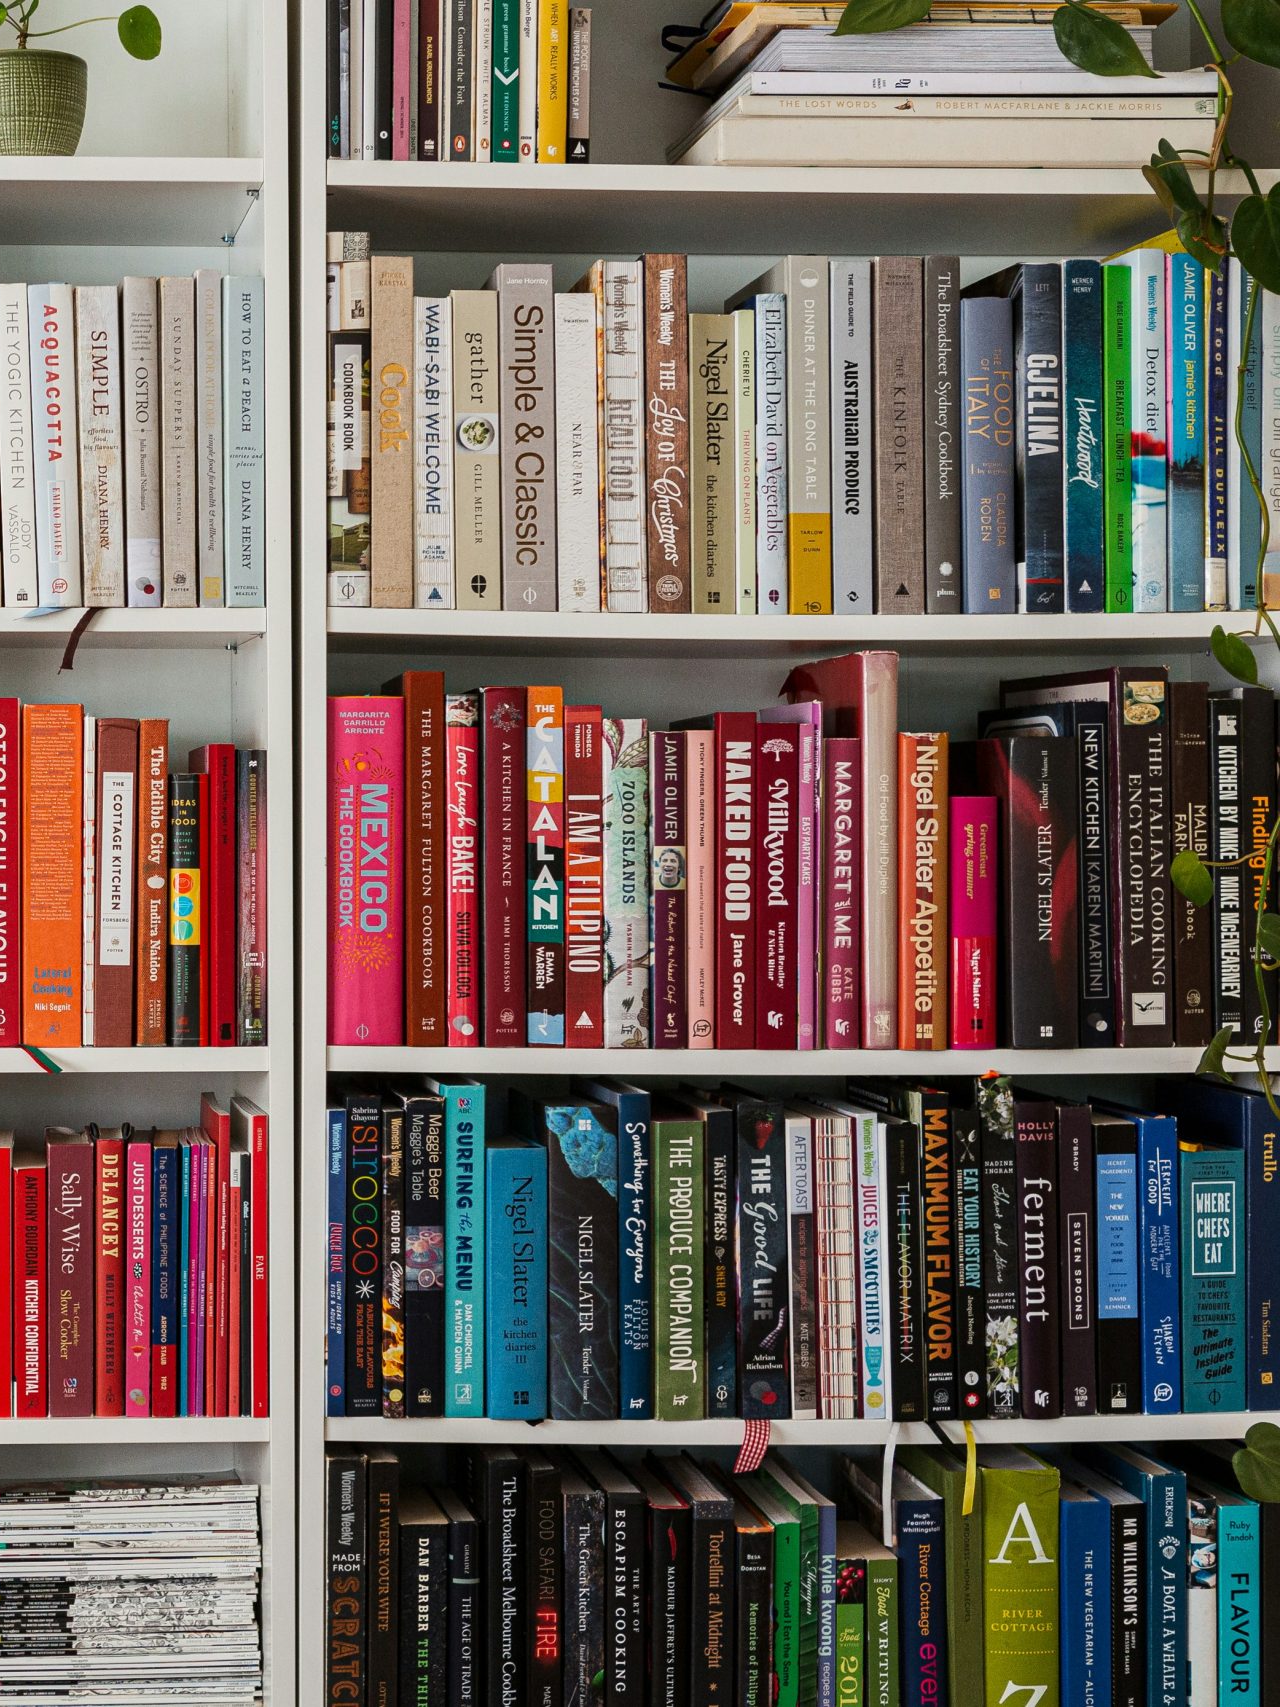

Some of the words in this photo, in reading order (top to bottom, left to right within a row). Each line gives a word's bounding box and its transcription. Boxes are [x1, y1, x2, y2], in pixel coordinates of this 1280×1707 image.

[457, 72, 465, 85] the
[457, 86, 465, 104] Fork
[806, 100, 831, 108] LOST
[40, 305, 62, 461] ACQUACOTTA
[91, 331, 109, 416] SIMPLE
[425, 305, 440, 408] WABI-SABI
[508, 305, 543, 411] Simple
[699, 338, 728, 396] Nigel
[1147, 348, 1159, 390] Detox
[344, 363, 353, 418] COOKBOOK
[1027, 354, 1058, 456] GJELINA
[1147, 397, 1159, 433] diet
[344, 424, 353, 450] BOOK
[515, 423, 544, 444] &
[706, 402, 728, 465] Slater
[426, 413, 441, 514] WELCOME
[242, 481, 251, 525] DIANA
[515, 452, 544, 565] Classic
[242, 531, 251, 569] HENRY
[910, 746, 938, 809] Nigel
[1085, 730, 1098, 770] NEW
[340, 785, 353, 816] THE
[726, 742, 751, 840] NAKED
[1086, 774, 1100, 851] KITCHEN
[340, 821, 353, 927] COOKBOOK
[360, 784, 388, 932] MEXICO
[916, 815, 938, 892] Slater
[726, 845, 750, 920] FOOD
[730, 933, 745, 967] Jane
[915, 899, 938, 1012] Appetite
[50, 1003, 70, 1012] Segnit
[733, 972, 745, 1025] Grover
[1018, 1122, 1054, 1130] HOLLY
[1020, 1133, 1053, 1141] DAVIS
[925, 1109, 949, 1246] MAXIMUM
[1196, 1192, 1230, 1213] WHERE
[102, 1154, 118, 1257] DELANCEY
[1198, 1218, 1229, 1238] CHEFS
[1024, 1178, 1052, 1322] ferment
[1205, 1243, 1222, 1263] EAT
[26, 1280, 38, 1321] KITCHEN
[927, 1255, 951, 1360] FLAVOR
[26, 1326, 38, 1395] CONFIDENTIAL
[419, 1538, 429, 1566] DAN
[989, 1502, 1054, 1563] A
[1226, 1533, 1254, 1541] Tandoh
[1230, 1521, 1250, 1531] Ruby
[418, 1574, 429, 1631] BARBER
[991, 1622, 1052, 1634] COTTAGE
[1002, 1610, 1042, 1618] RIVER
[1231, 1574, 1250, 1692] FLAVOUR
